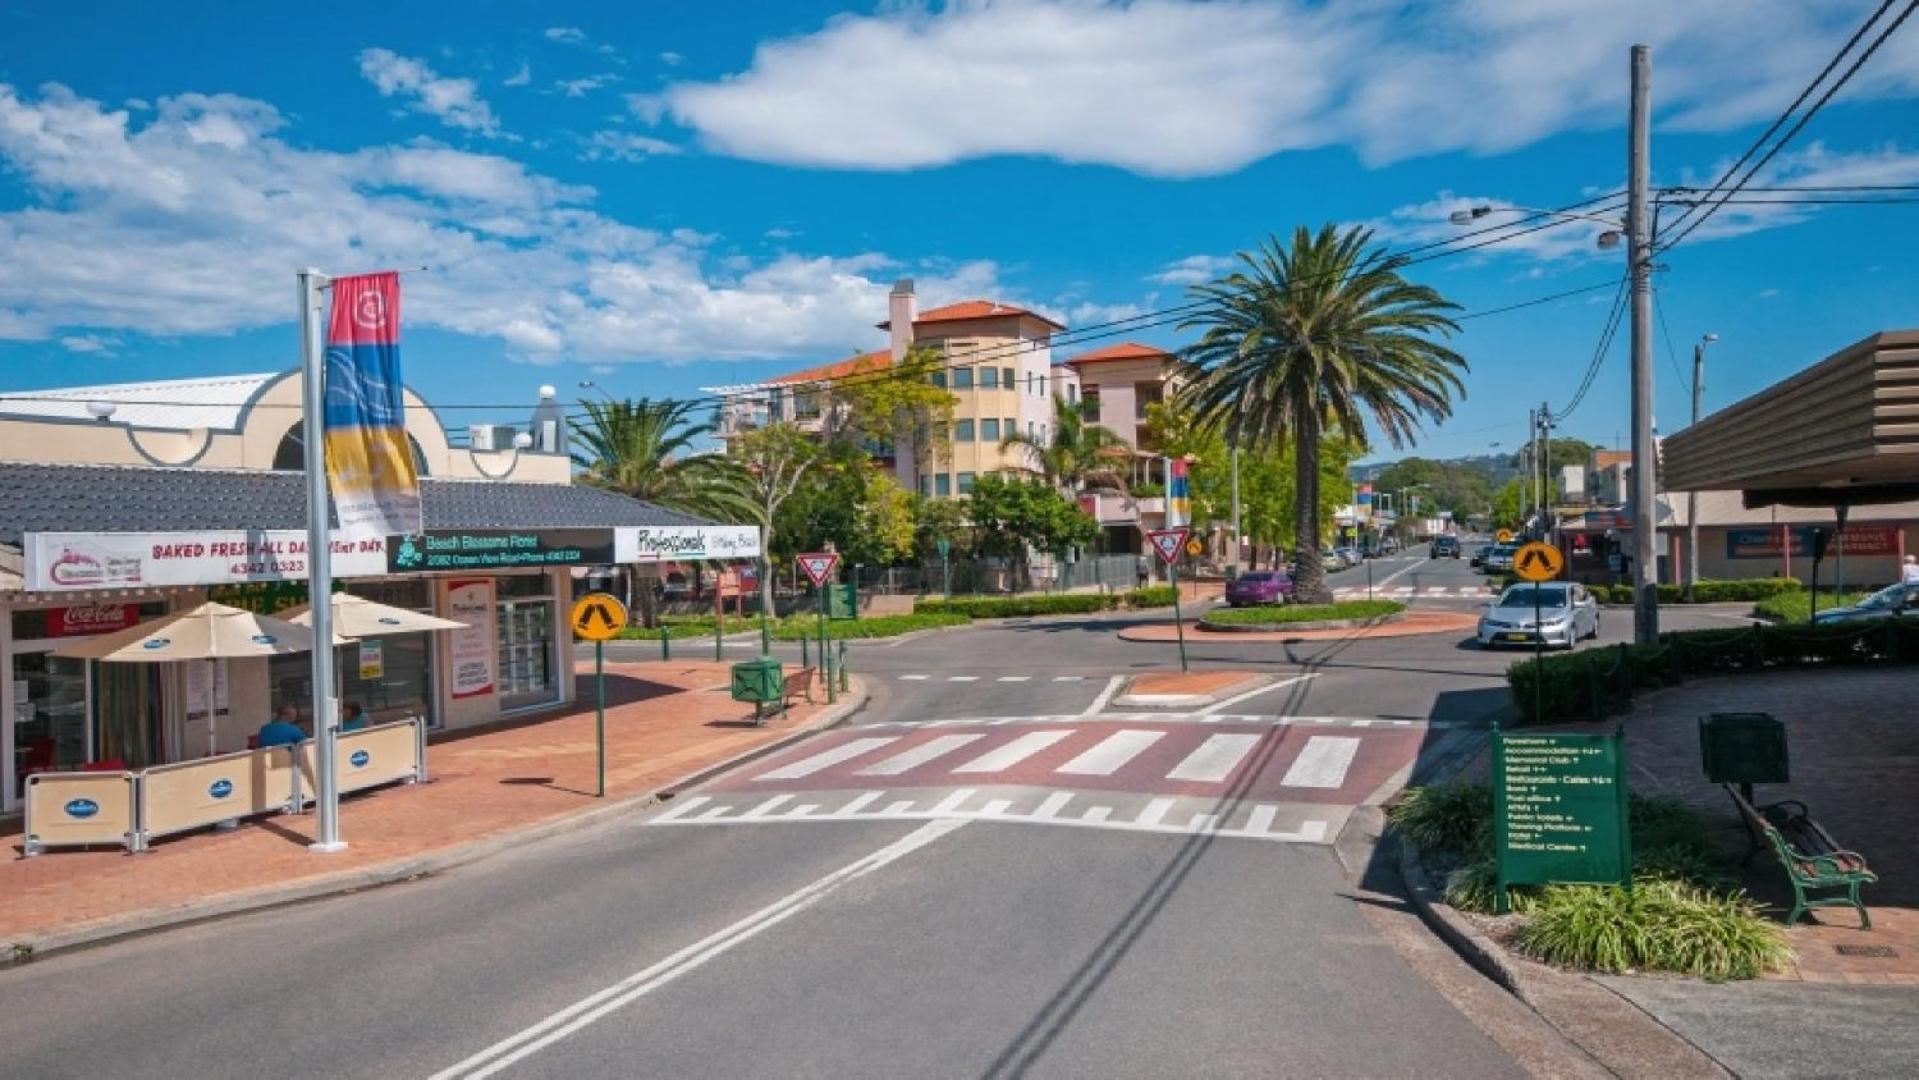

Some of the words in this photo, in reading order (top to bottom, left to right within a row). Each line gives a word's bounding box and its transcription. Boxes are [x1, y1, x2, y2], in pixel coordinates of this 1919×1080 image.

[152, 543, 205, 561] BAKED
[210, 541, 255, 558] FRESH
[258, 540, 285, 555] ALL
[288, 539, 309, 555] DA
[638, 529, 706, 552] Professionals
[1505, 747, 1579, 755] Accommodation
